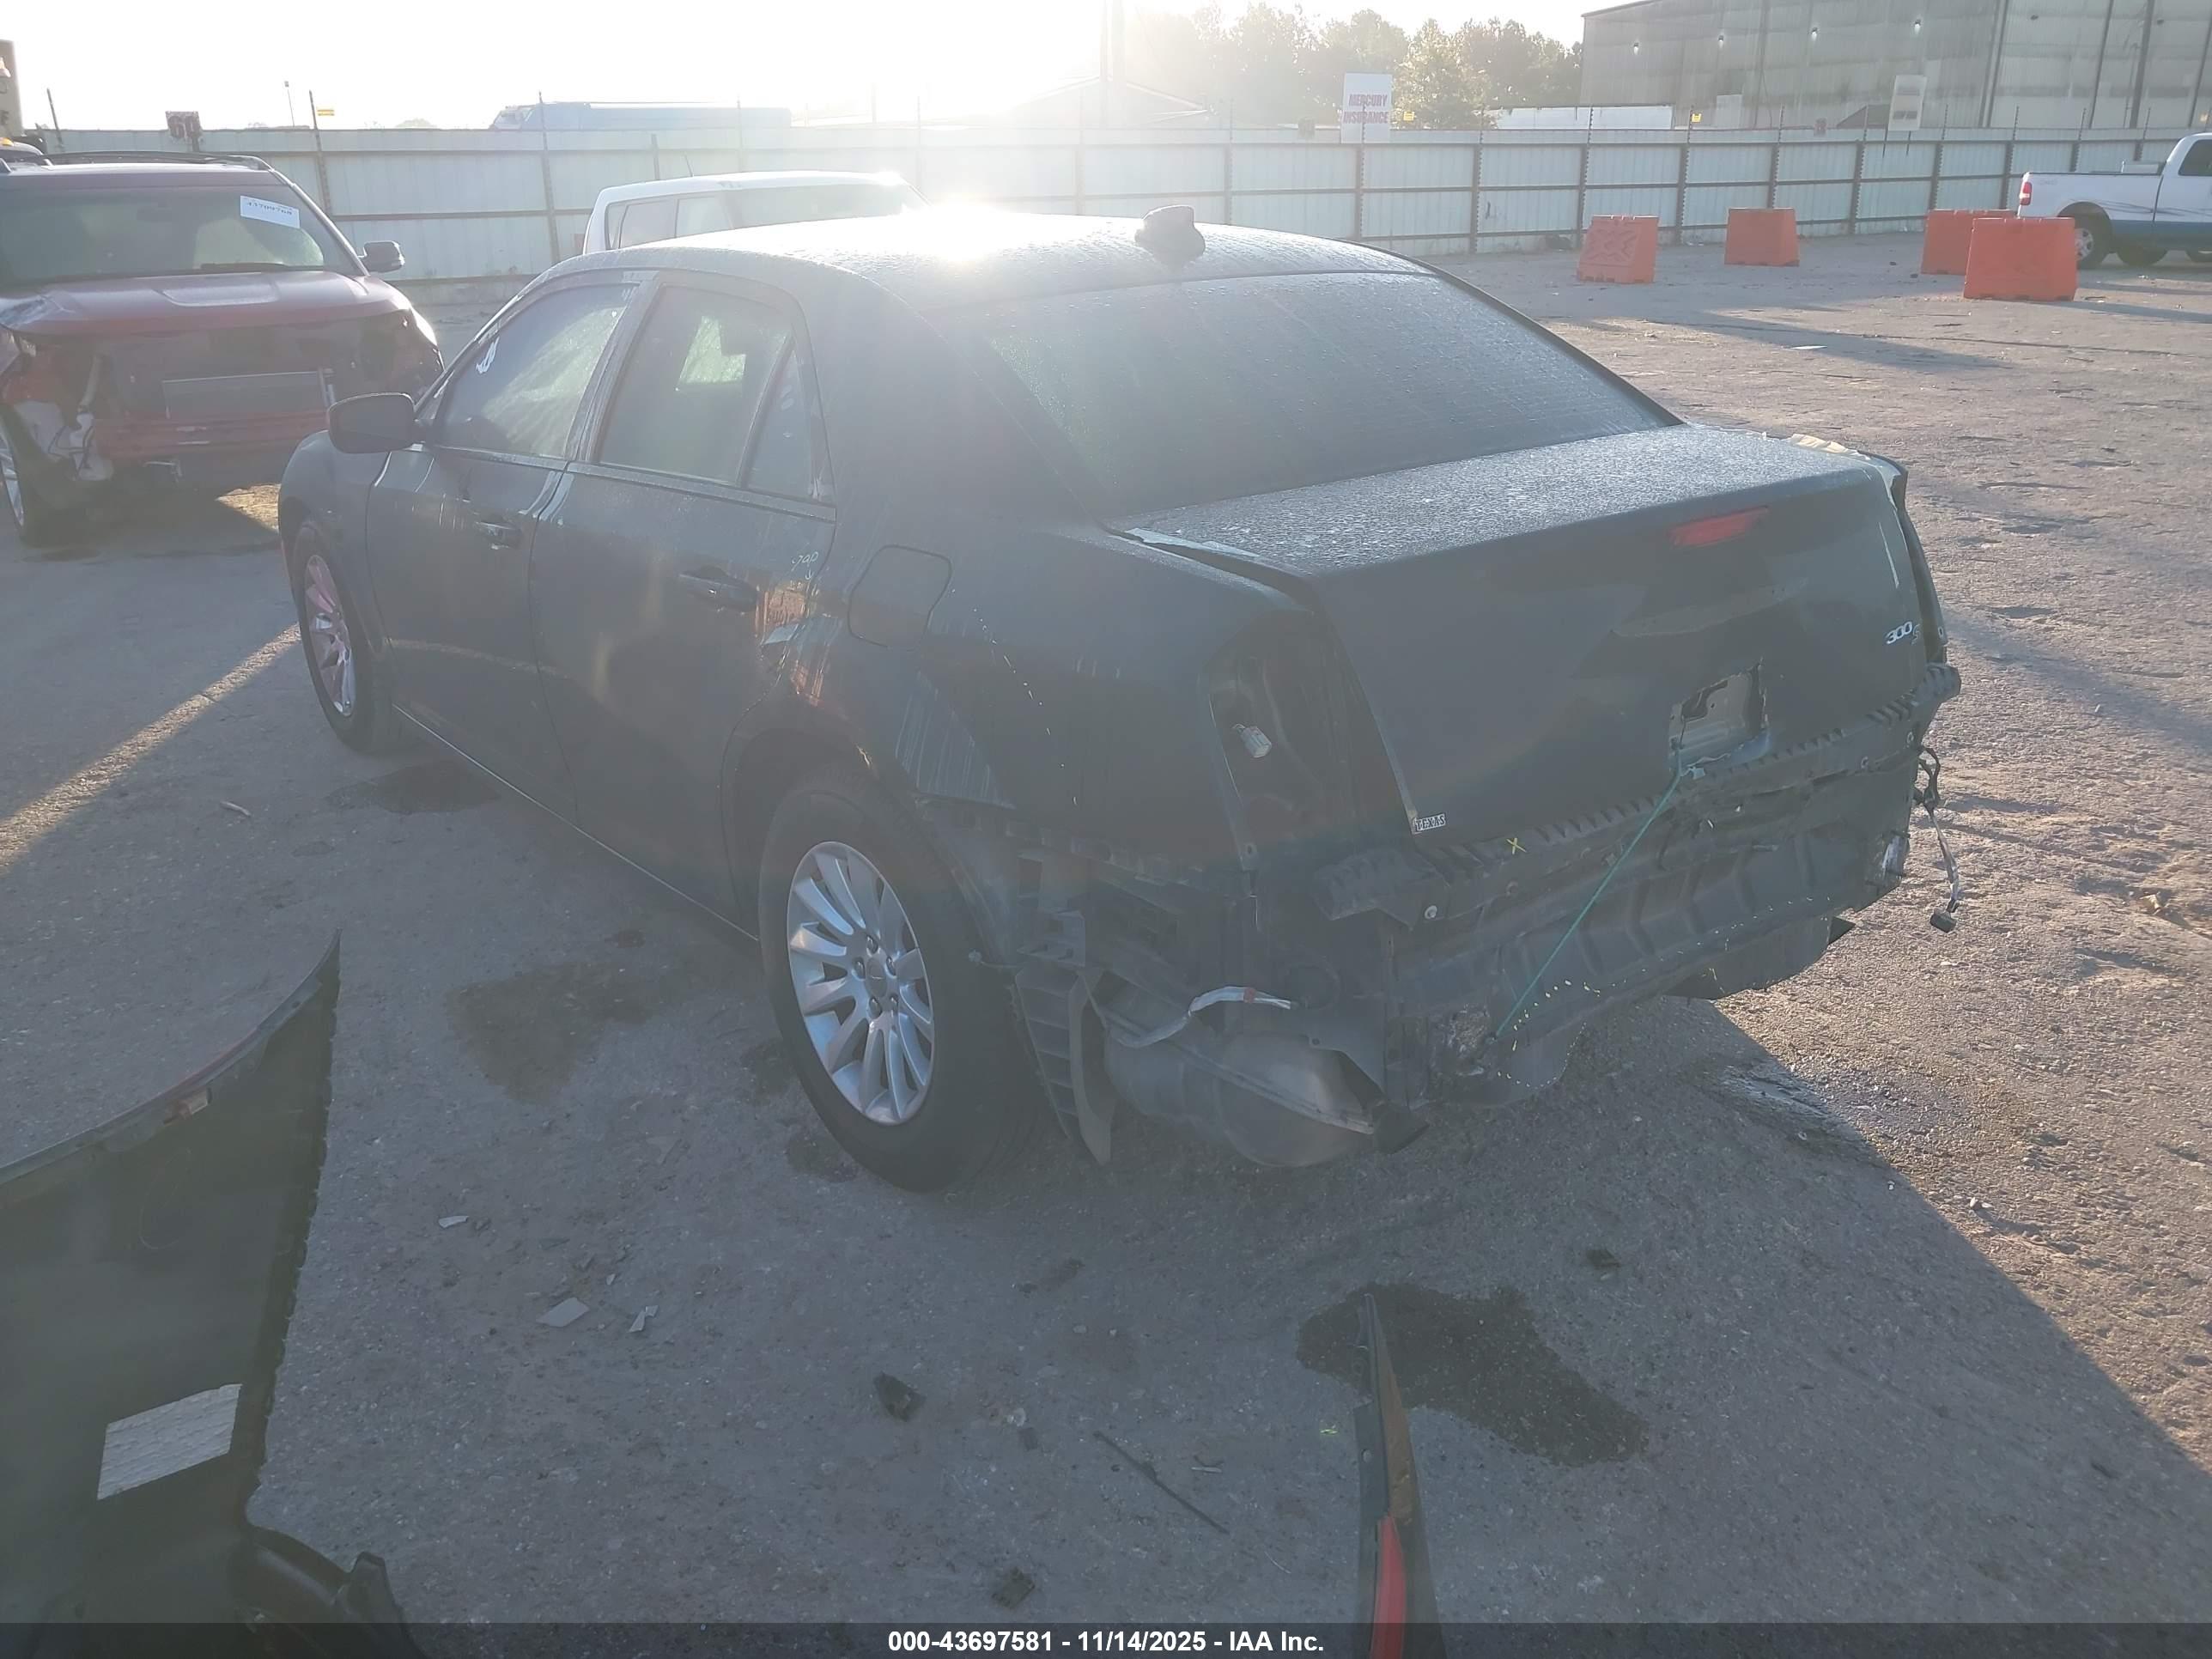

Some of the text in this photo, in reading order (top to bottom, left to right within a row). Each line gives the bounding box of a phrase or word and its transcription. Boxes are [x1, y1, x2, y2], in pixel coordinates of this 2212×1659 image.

[1349, 94, 1388, 106] MERCURY
[1343, 111, 1389, 124] INSURANCE
[1885, 621, 1913, 645] 300
[1415, 814, 1445, 831] TEXAS
